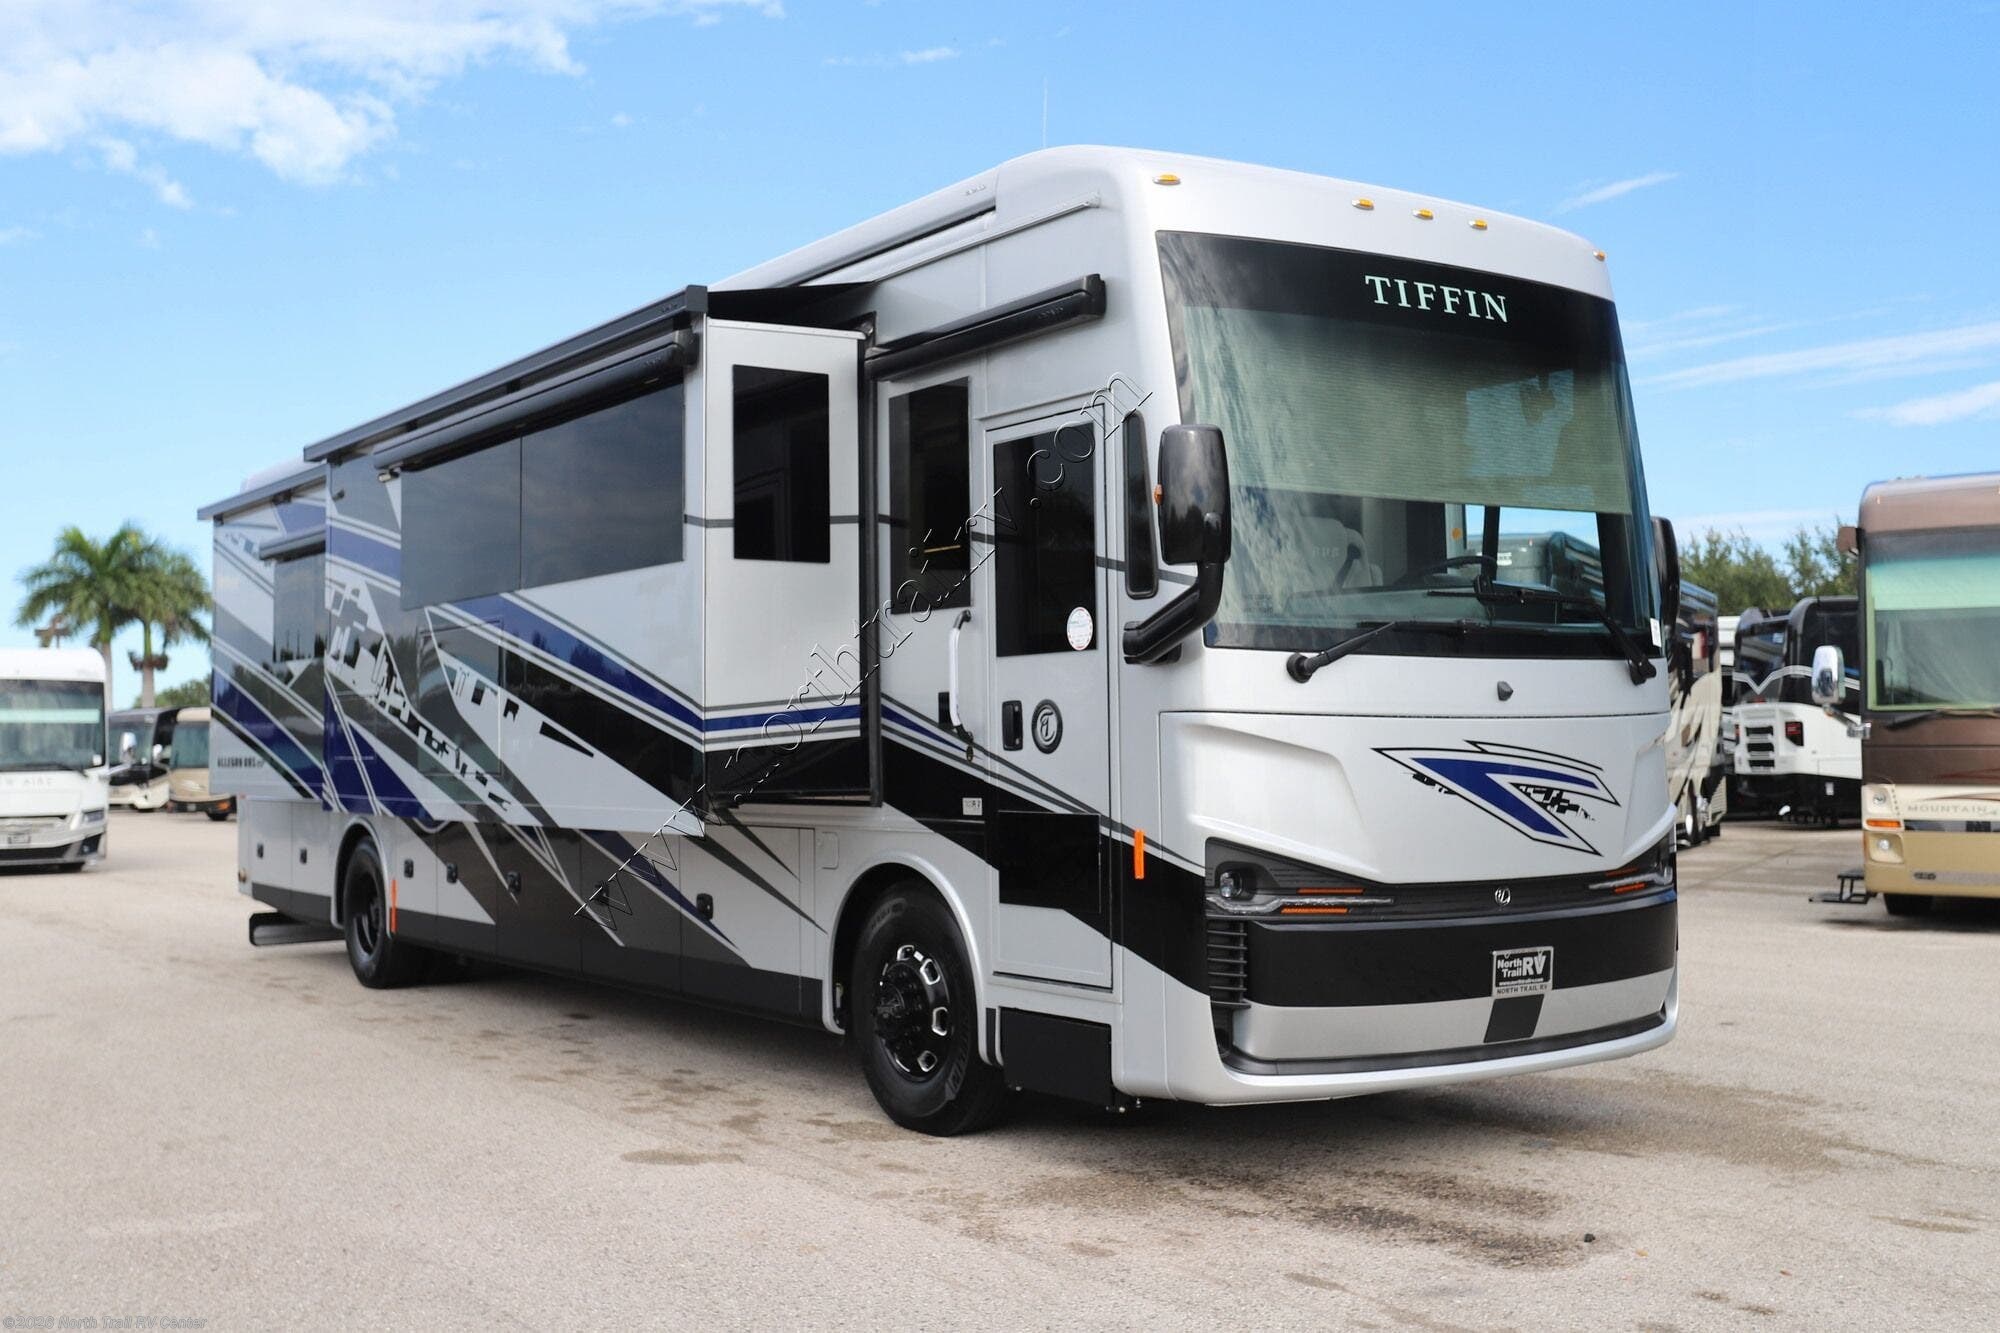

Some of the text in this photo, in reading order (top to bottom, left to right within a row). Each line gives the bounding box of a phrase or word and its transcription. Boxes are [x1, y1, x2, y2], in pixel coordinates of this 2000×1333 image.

[1364, 275, 1508, 323] TIFFIN
[1907, 805, 1987, 813] MOUNTAIN
[1497, 958, 1522, 969] North
[1522, 955, 1547, 976] RV
[1501, 967, 1522, 978] Trail
[1497, 983, 1548, 994] NORTH TRAIL RV
